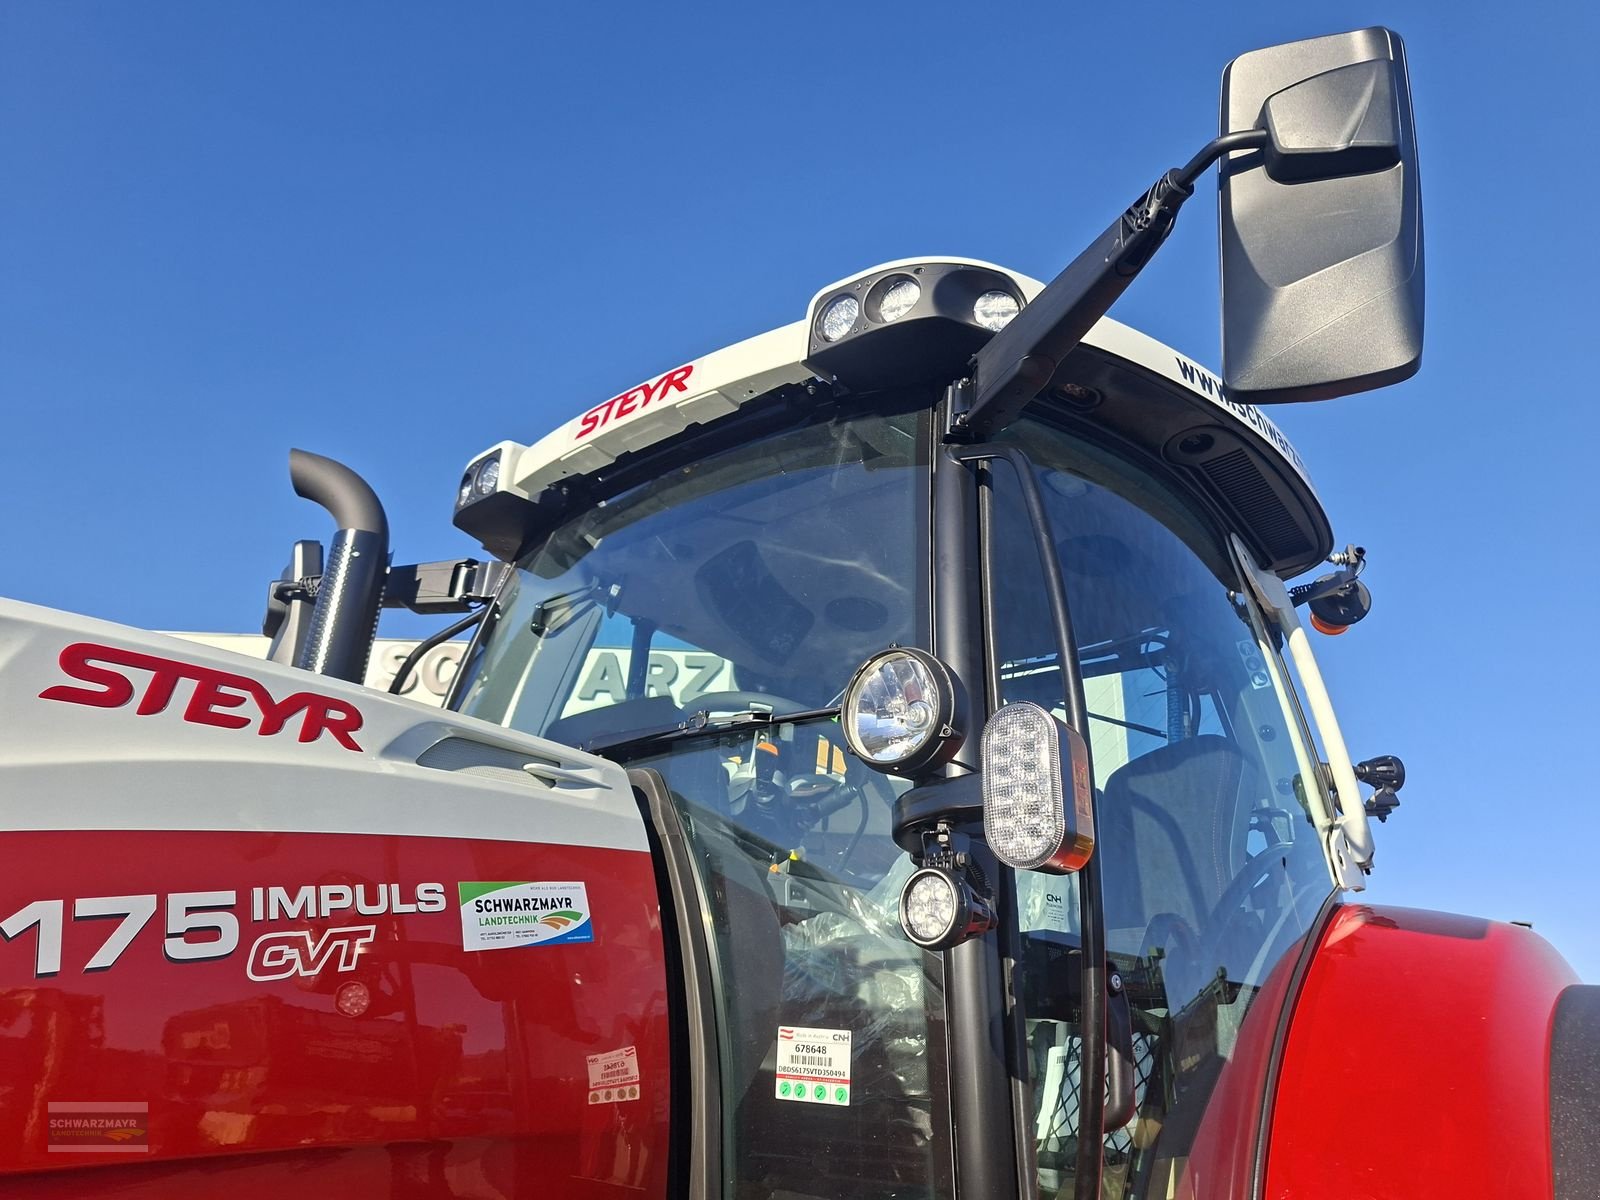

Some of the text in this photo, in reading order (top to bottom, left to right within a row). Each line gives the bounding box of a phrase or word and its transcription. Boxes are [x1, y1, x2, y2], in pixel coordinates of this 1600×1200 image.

[575, 365, 693, 440] STEYR
[38, 642, 364, 753] STEYR
[251, 882, 446, 922] IMPULS
[475, 897, 573, 914] SCHWARZMAYR
[479, 914, 539, 927] LANDTECHNIK
[0, 890, 239, 977] 175
[246, 924, 376, 982] CVT
[795, 1044, 827, 1054] 678648
[832, 1034, 850, 1042] CNH
